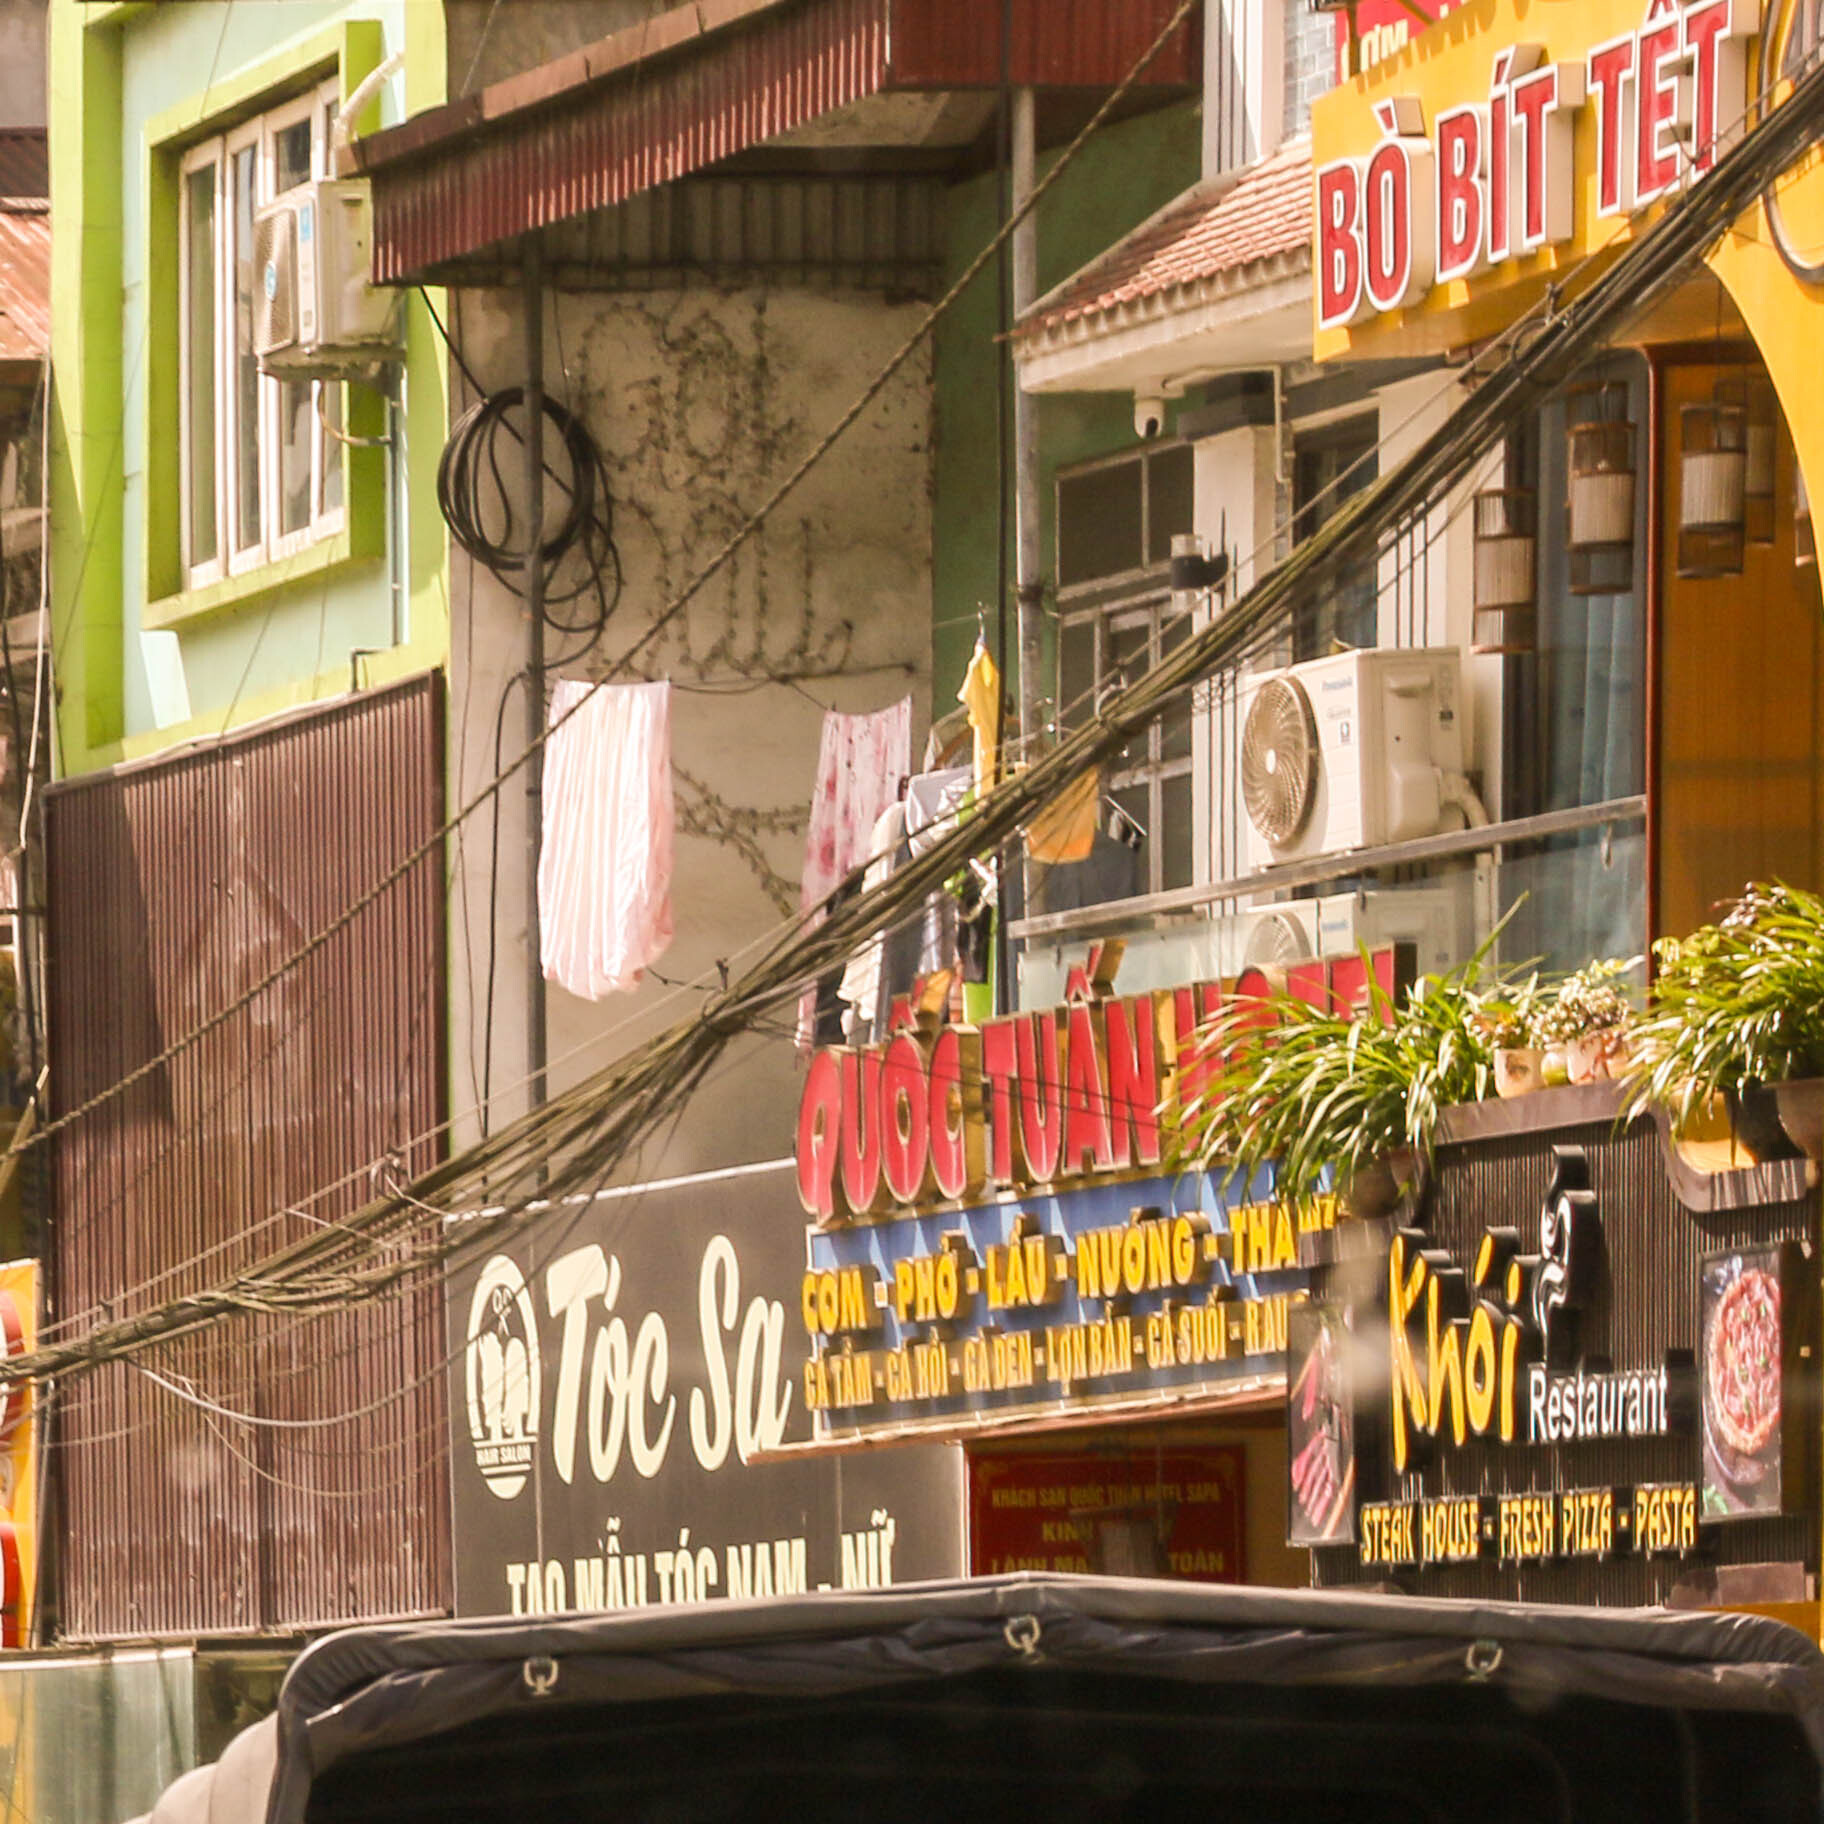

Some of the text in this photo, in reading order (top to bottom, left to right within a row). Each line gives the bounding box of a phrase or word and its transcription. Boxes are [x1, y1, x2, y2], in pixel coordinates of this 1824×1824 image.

[1318, 0, 1732, 331] BÒ BÍT TẾT
[796, 974, 968, 1226] QUỐC
[983, 942, 1160, 1186] TUẤN
[894, 1230, 960, 1321] PHỞ
[986, 1214, 1047, 1308] LẨU
[1076, 1209, 1195, 1298] NƯỚNG
[546, 1243, 676, 1486] Tóc
[1530, 1369, 1669, 1441] Restaurant
[476, 1444, 533, 1465] HAIR SALON
[726, 1537, 808, 1602] NAM
[1361, 1486, 1696, 1565] STEAK HOUSE FRESH PIZZA PASTA
